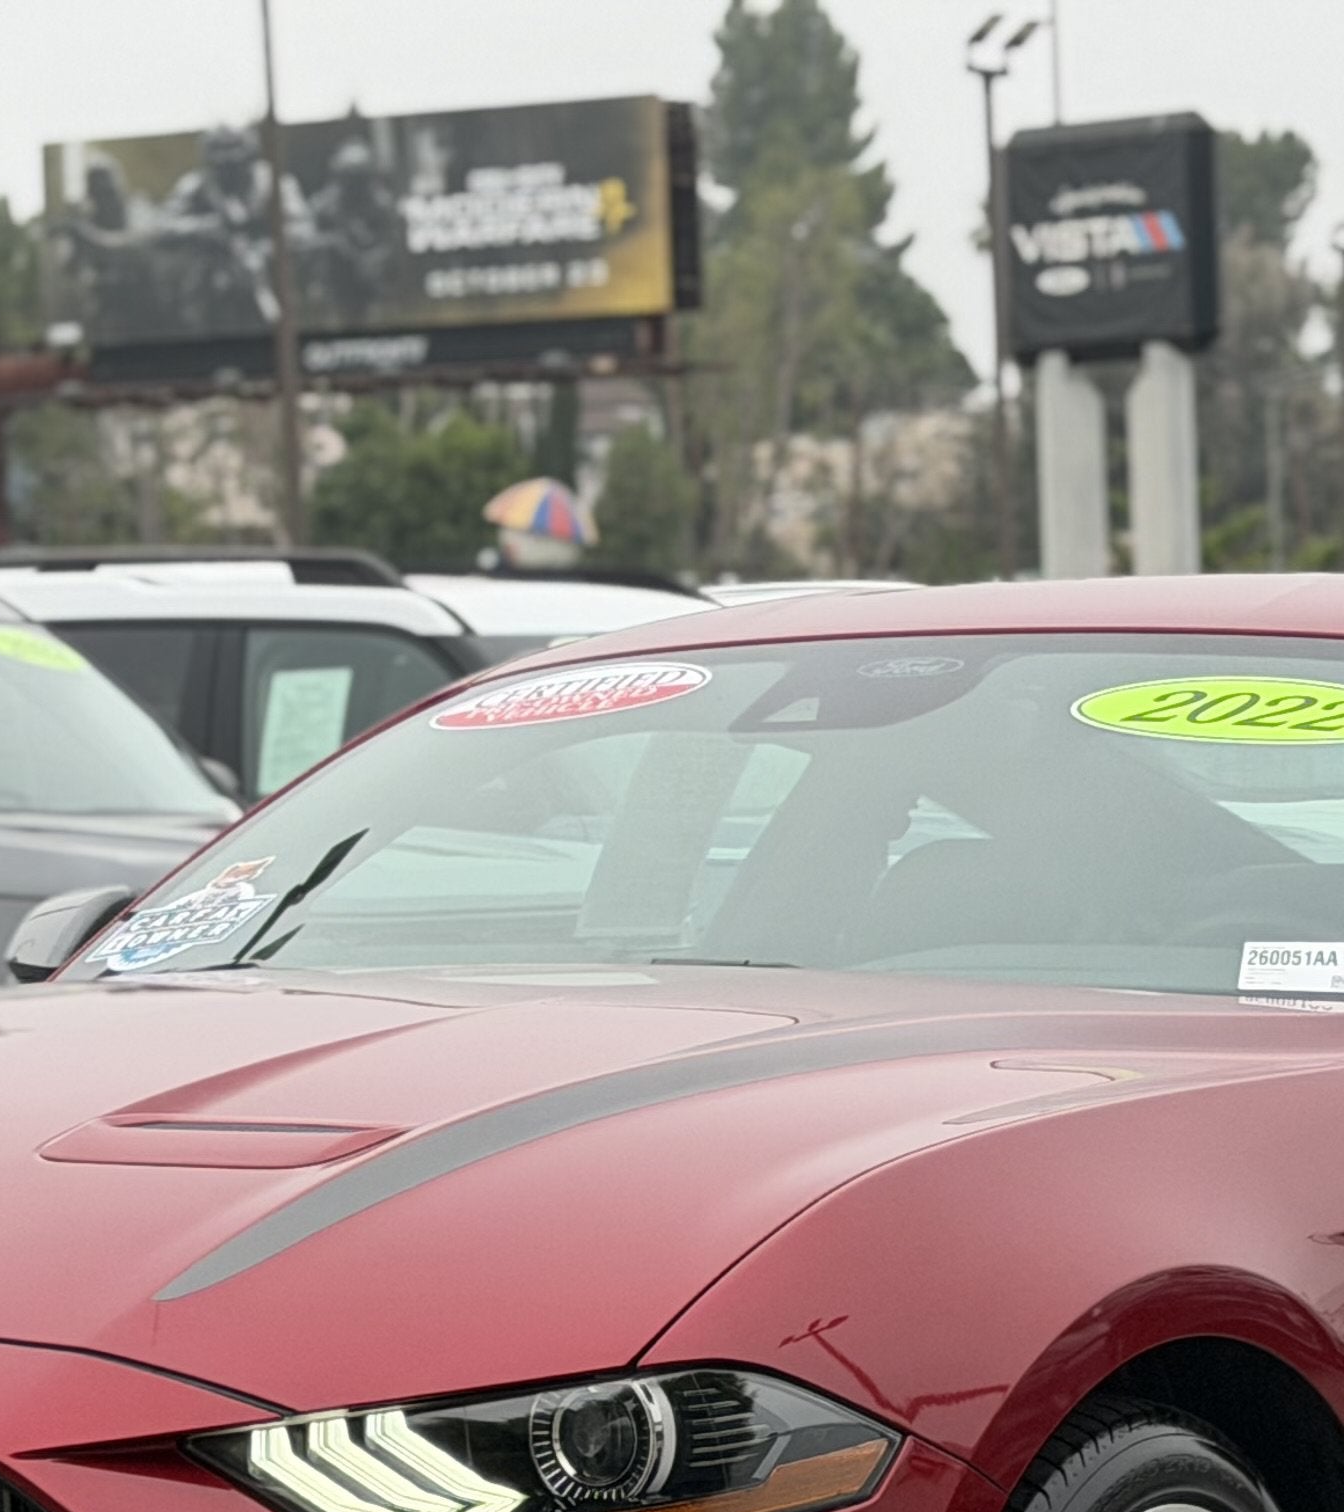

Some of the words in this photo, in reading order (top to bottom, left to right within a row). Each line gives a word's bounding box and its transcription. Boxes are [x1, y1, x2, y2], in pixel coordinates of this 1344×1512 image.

[1010, 214, 1142, 265] VISTA
[476, 671, 687, 708] CERTIFIED
[128, 923, 231, 948] OWNER
[1247, 950, 1339, 967] 260051AA
